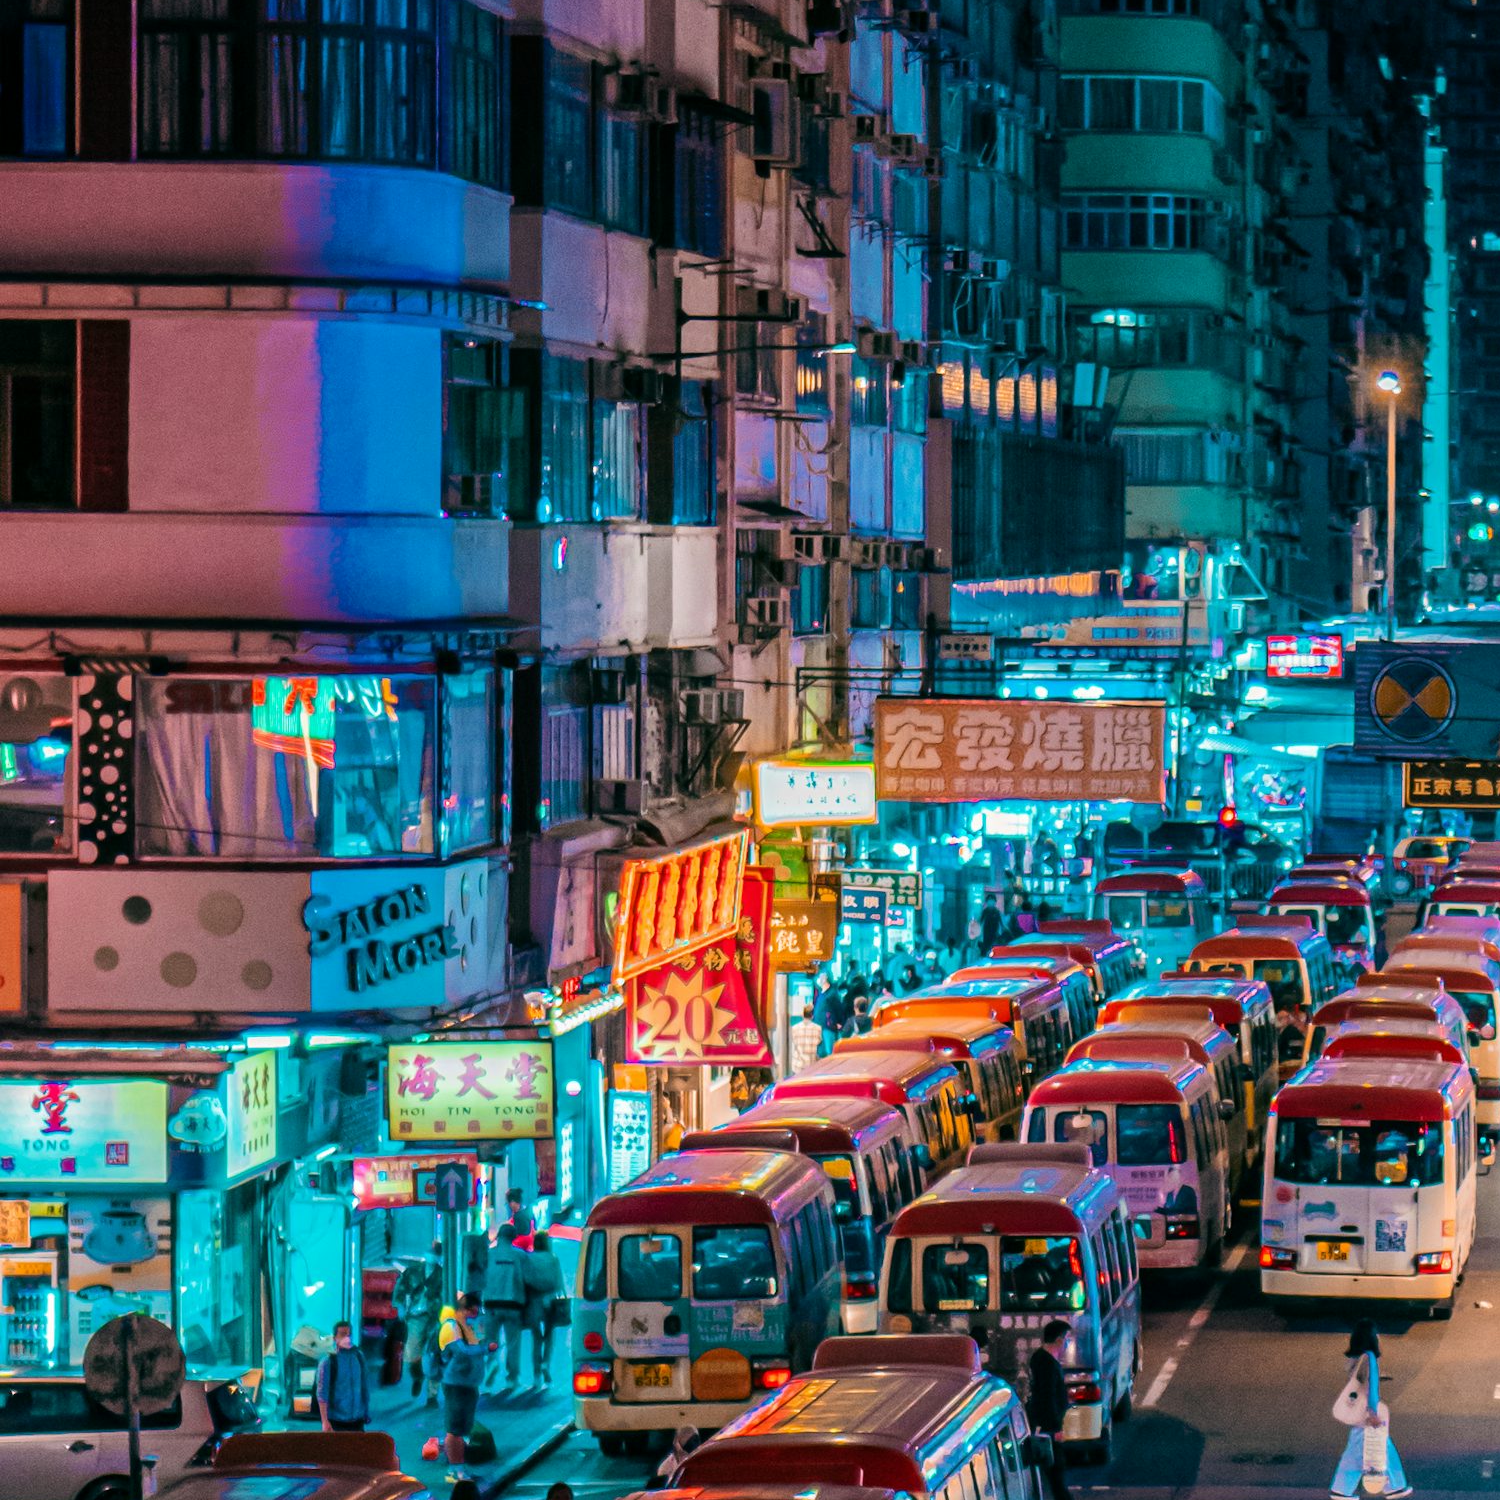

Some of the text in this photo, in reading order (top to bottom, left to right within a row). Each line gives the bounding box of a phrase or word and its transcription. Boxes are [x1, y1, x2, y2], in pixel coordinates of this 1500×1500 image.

[883, 708, 1157, 773] 宏發燒臘
[303, 883, 432, 958] SALON
[769, 928, 824, 956] 飩皇
[346, 924, 461, 993] MORE
[651, 994, 760, 1045] 20 元起
[397, 1052, 548, 1101] 海天堂
[31, 1080, 81, 1134] 堂
[400, 1105, 536, 1116] HOI TIN TONG
[22, 1138, 71, 1152] TONG
